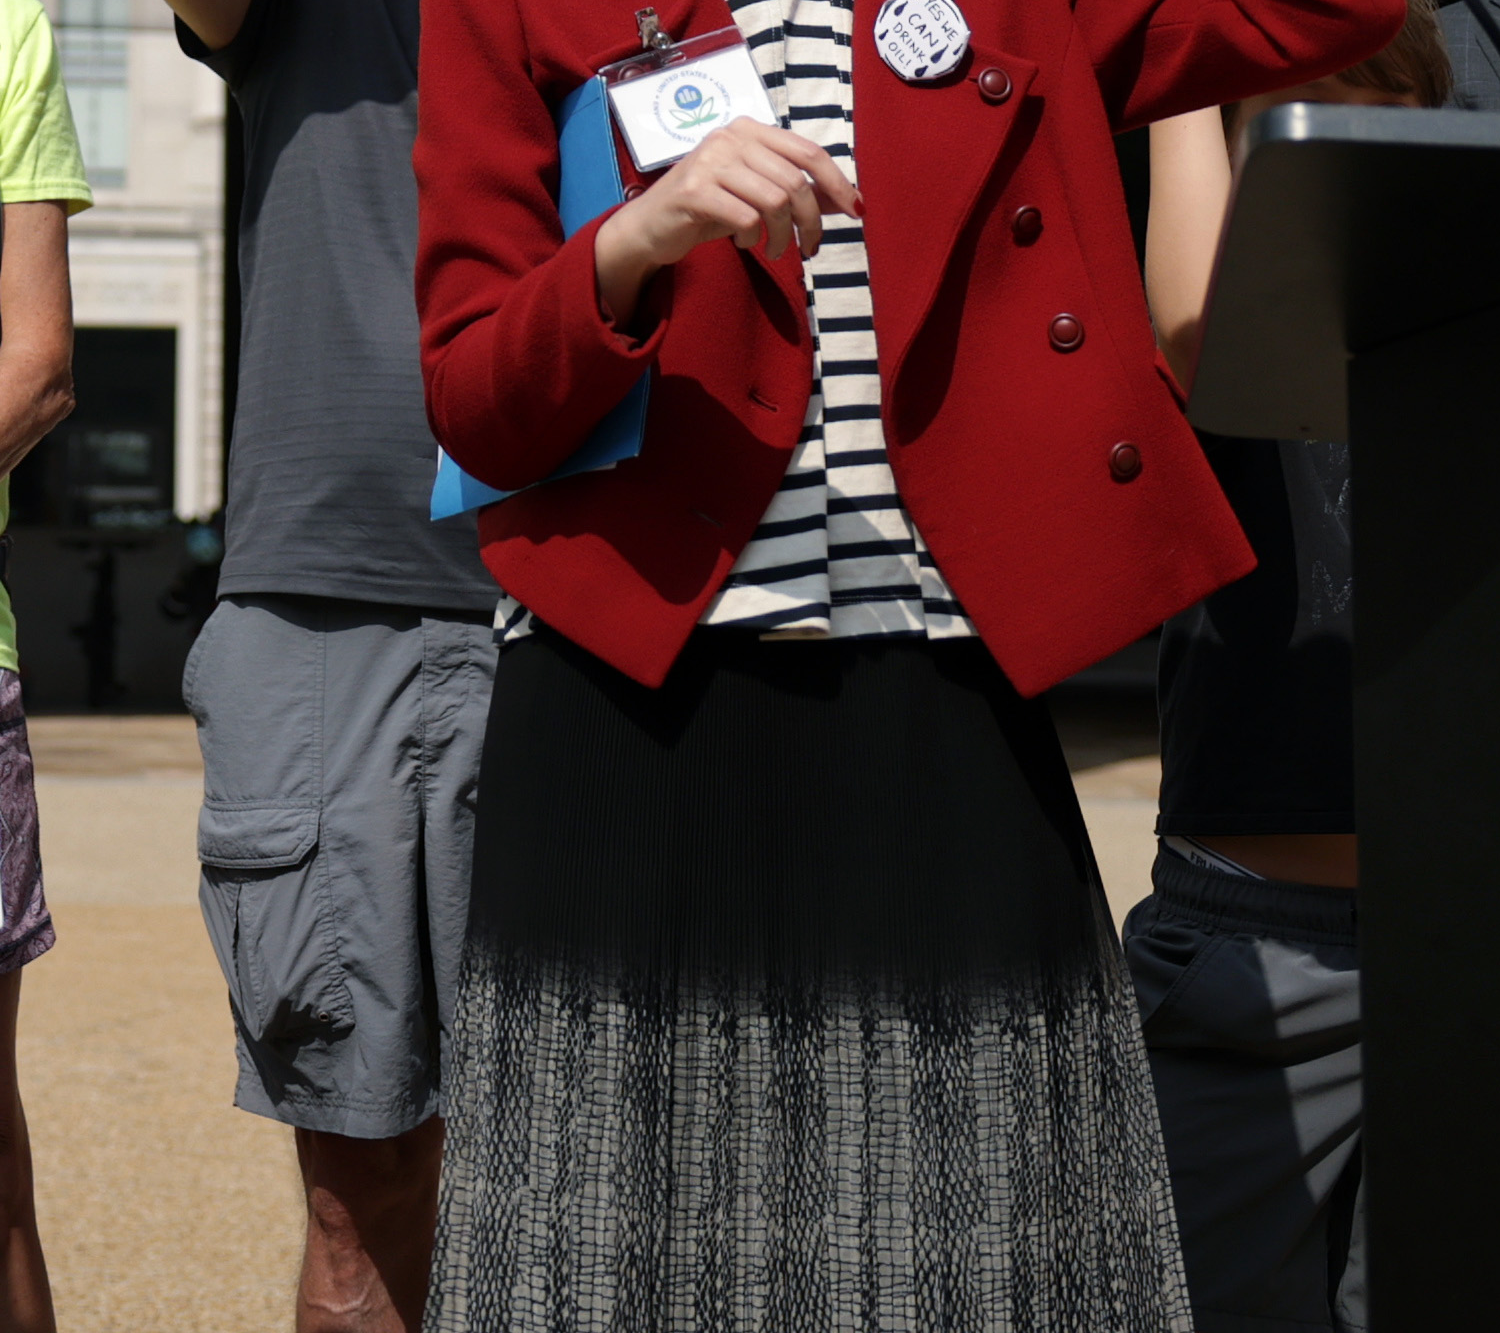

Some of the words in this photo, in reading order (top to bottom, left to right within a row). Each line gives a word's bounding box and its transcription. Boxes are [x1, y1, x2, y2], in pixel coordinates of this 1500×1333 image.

[893, 22, 928, 63] DRINK
[908, 13, 940, 48] CAN
[941, 20, 959, 42] WE
